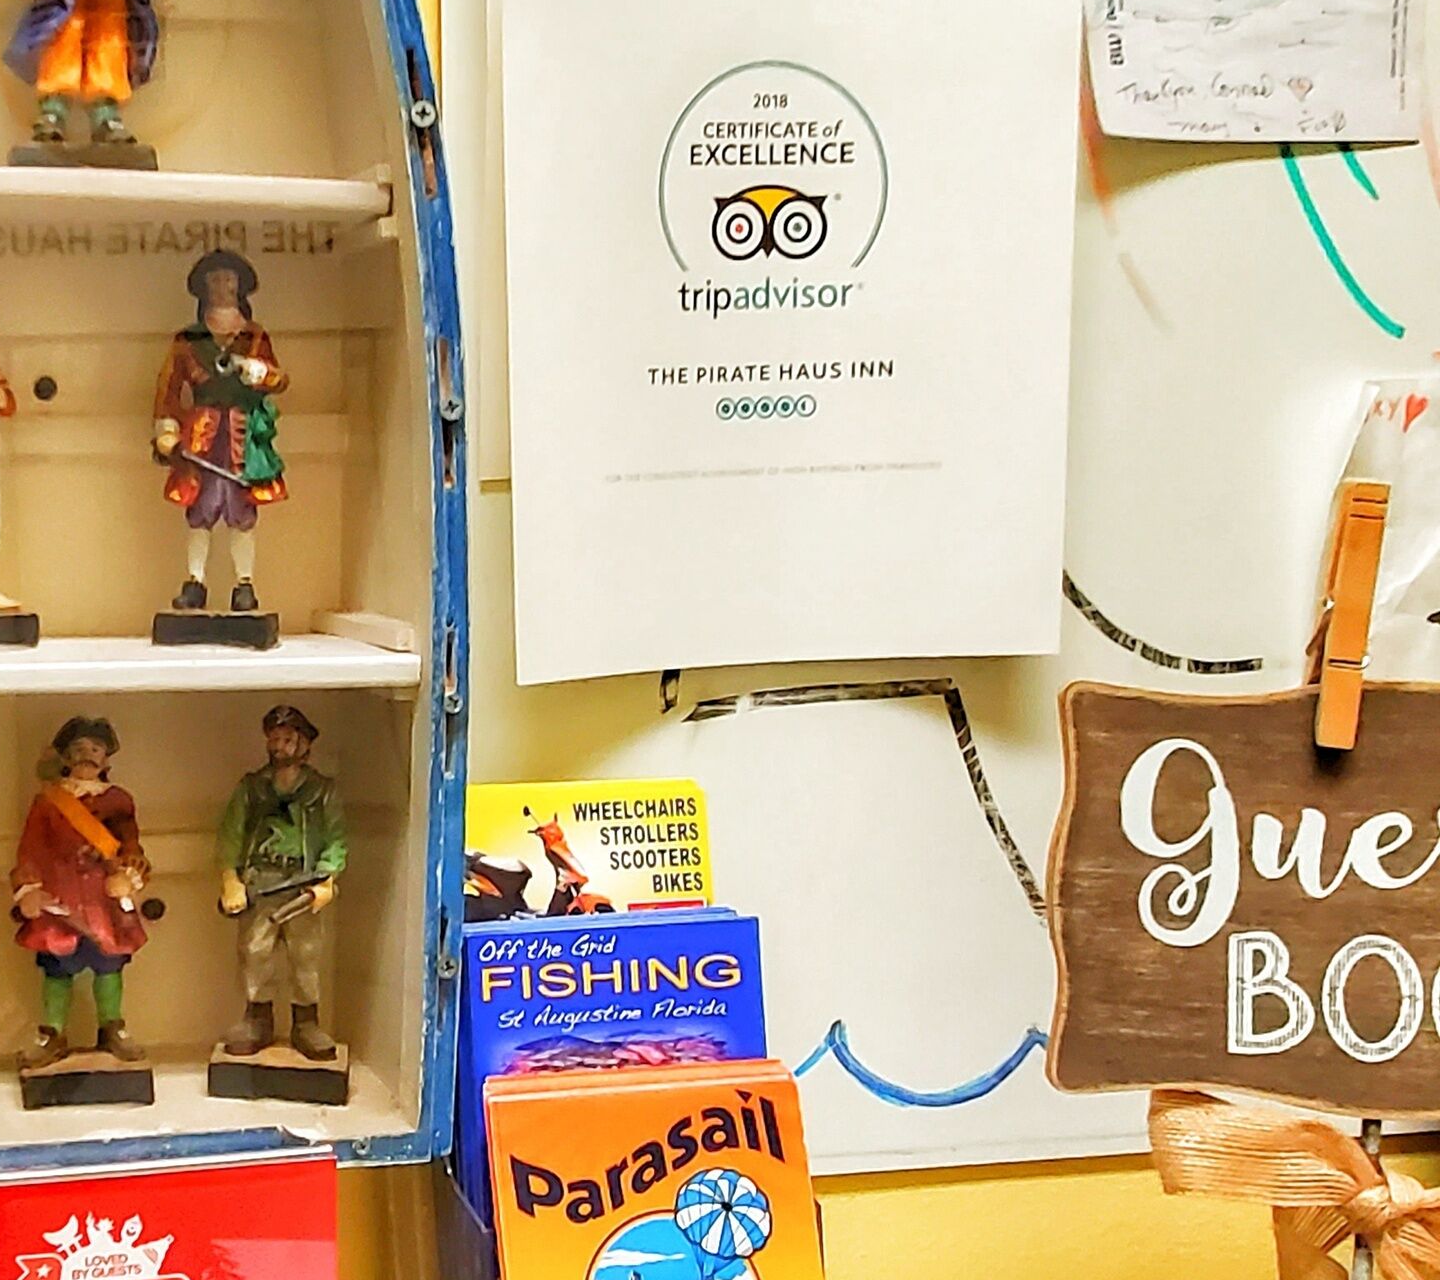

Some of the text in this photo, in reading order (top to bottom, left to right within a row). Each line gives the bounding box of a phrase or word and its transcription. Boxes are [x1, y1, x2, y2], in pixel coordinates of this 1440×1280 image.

[752, 93, 789, 110] 2018
[702, 120, 845, 140] CERTIFICATE of
[689, 141, 856, 167] EXCELLENCE
[677, 275, 855, 320] tripadvisor
[647, 360, 895, 386] THE PIRATE HAUS INN
[572, 797, 698, 822] WHEELCHAIRS
[599, 822, 699, 846] STROLLERS
[1119, 737, 1440, 947] gue
[609, 847, 702, 870] SCOOTERS
[652, 872, 704, 894] BIKES
[478, 933, 617, 963] Off the Grid
[480, 952, 743, 1004] FISHING
[1227, 931, 1440, 1063] BO
[497, 999, 728, 1032] St Augustine Florida
[509, 1088, 786, 1224] Parasail
[71, 1263, 143, 1280] BY GUESTS
[84, 1253, 129, 1268] LOVED
